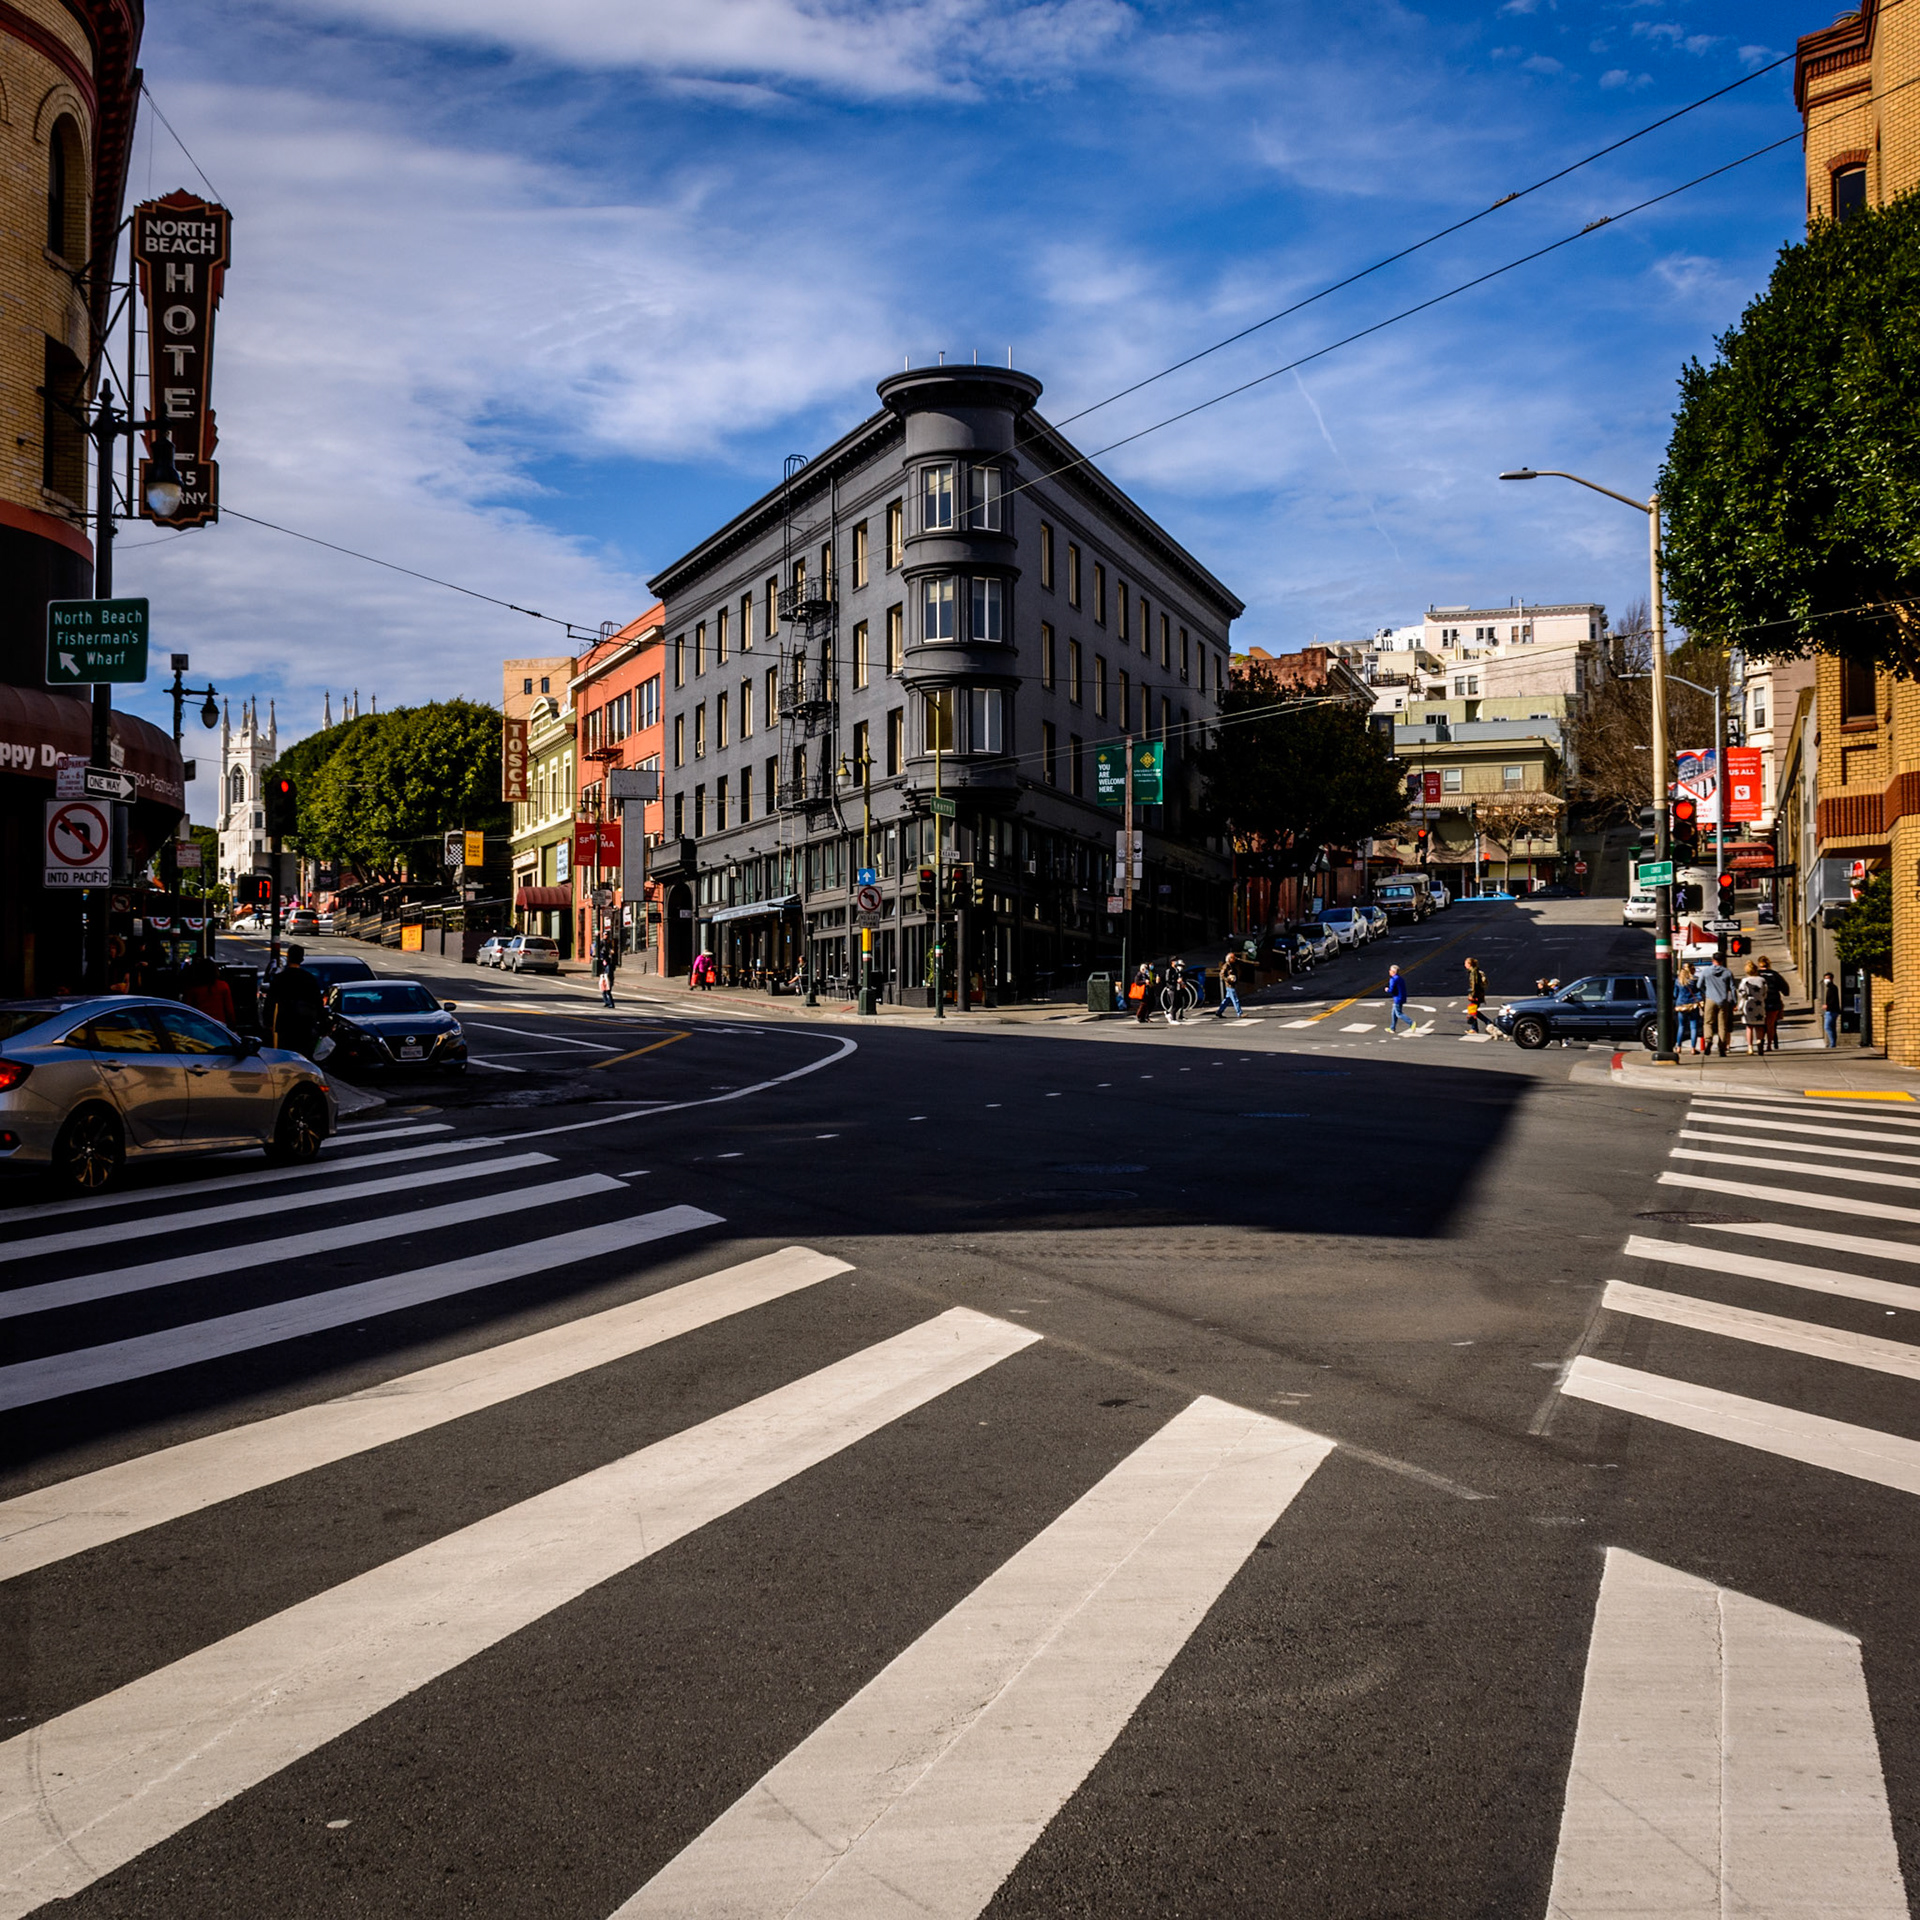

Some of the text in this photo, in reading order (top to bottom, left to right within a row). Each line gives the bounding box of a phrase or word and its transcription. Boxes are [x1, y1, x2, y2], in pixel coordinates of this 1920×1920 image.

[145, 220, 216, 238] NORTH
[145, 237, 216, 255] BEACH
[54, 609, 142, 625] North Beach
[56, 630, 139, 645] Fisherman's
[86, 651, 126, 665] Wharf
[508, 724, 523, 797] TOSCA
[90, 777, 121, 793] ONE WAY
[1098, 778, 1125, 786] WELCOME
[933, 800, 953, 815] Kearny
[47, 871, 108, 884] INTO PACIFIC
